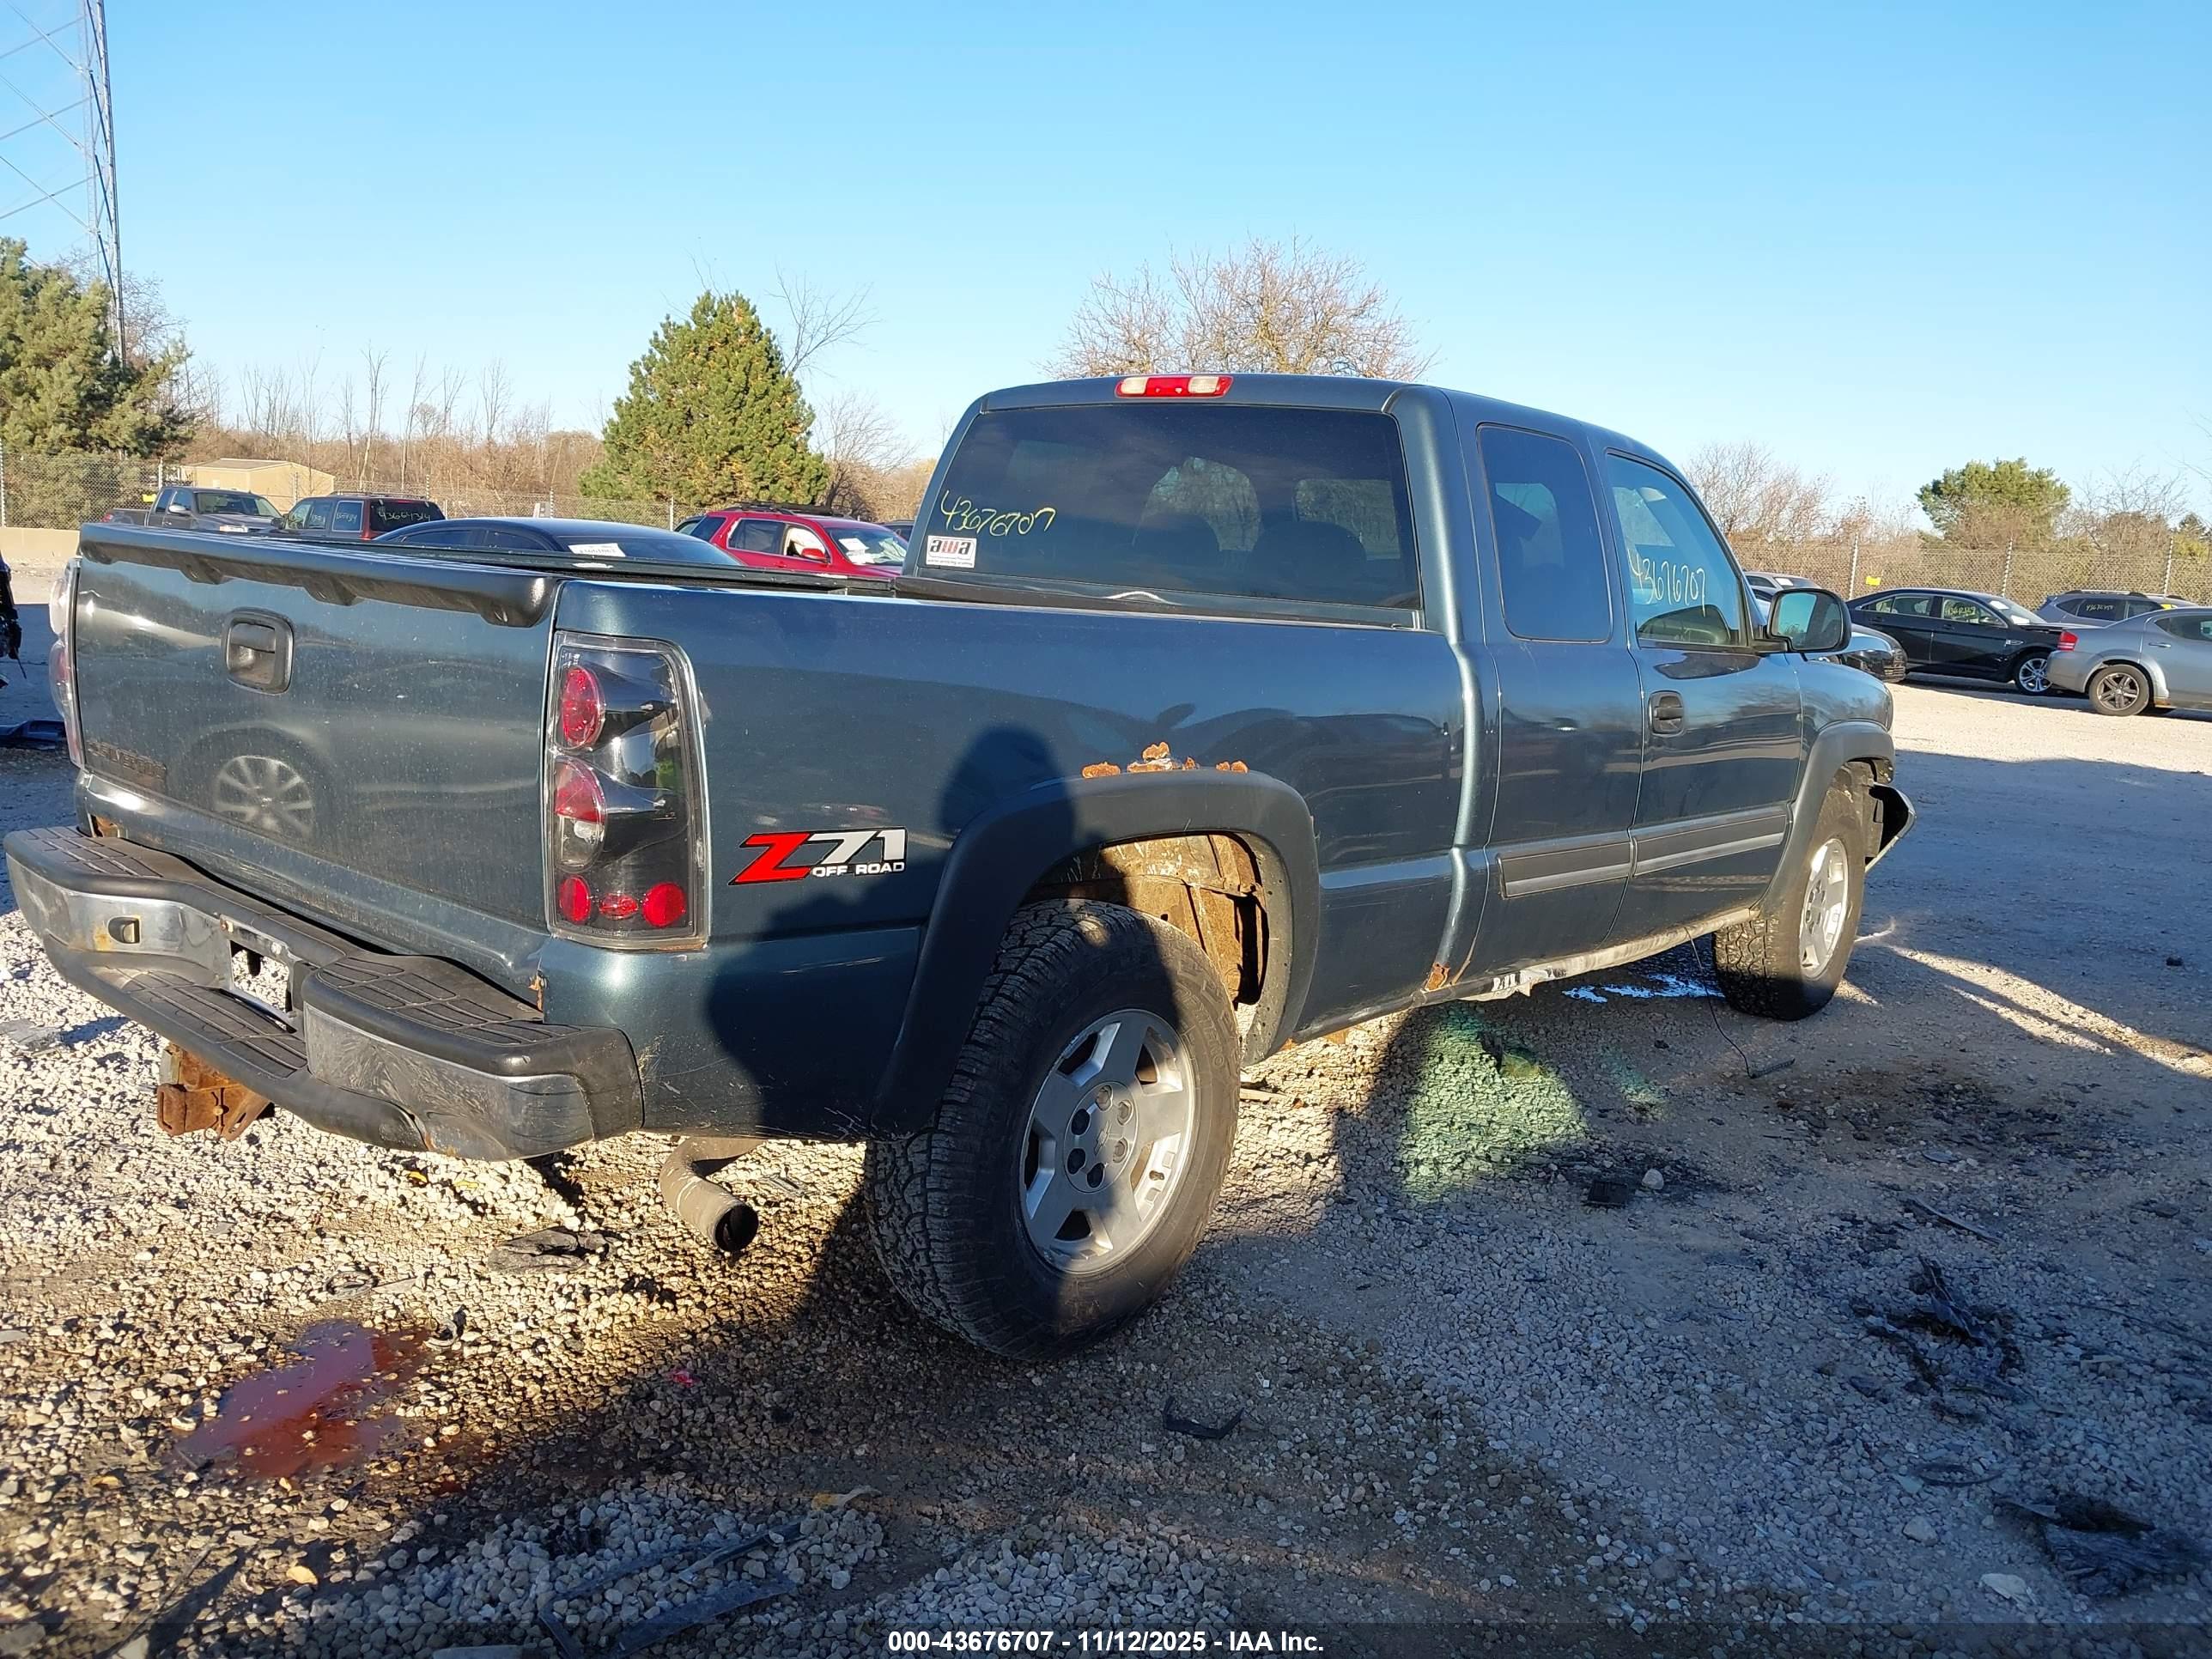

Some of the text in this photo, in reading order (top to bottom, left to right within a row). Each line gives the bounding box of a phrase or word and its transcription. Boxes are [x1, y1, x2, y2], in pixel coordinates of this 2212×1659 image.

[940, 489, 1056, 537] 43676707
[1627, 549, 1706, 617] 43676707
[729, 828, 907, 884] Z71
[812, 861, 905, 878] OFF ROAD
